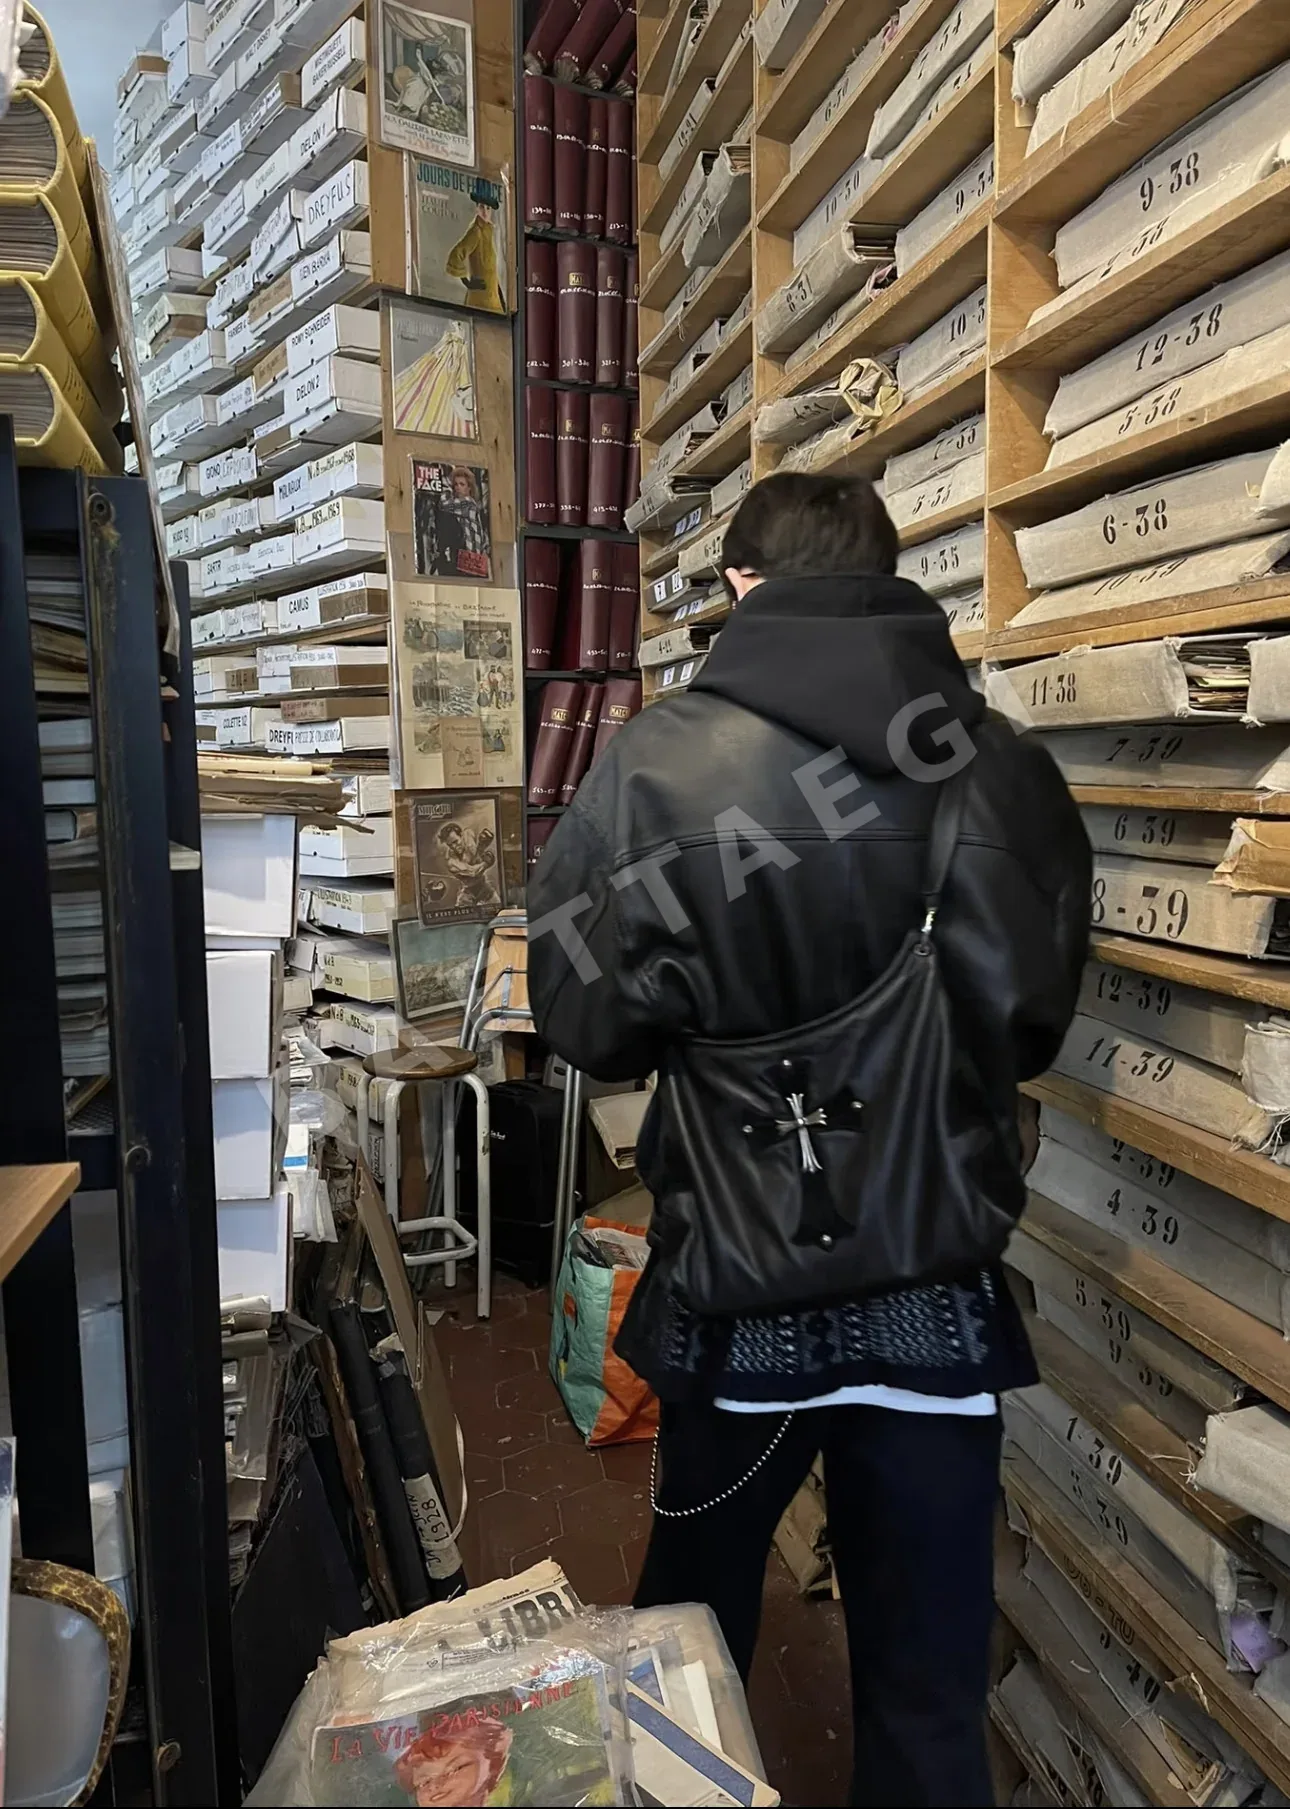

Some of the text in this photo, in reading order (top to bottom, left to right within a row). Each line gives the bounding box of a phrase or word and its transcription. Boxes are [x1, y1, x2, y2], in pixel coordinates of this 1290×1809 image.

[299, 130, 321, 157] DELON
[308, 172, 352, 226] DREYFUS
[416, 161, 451, 189] JOURS
[451, 171, 465, 192] DE
[824, 169, 860, 225] 10-30
[1139, 151, 1200, 212] 9-38
[304, 312, 332, 340] SCHNEIDER
[1135, 303, 1224, 372] 12-38
[295, 374, 321, 402] DELON 2
[1118, 386, 1182, 436] 5-38
[278, 476, 302, 501] MALRAUX
[416, 477, 443, 493] FACE
[418, 465, 440, 481] THE
[1102, 498, 1169, 545] 6-38
[920, 546, 960, 578] 9-35
[288, 596, 310, 615] CAMUS
[1030, 671, 1078, 706] 11-38
[223, 715, 242, 730] COLETTE
[453, 908, 471, 916] PLUS
[1091, 878, 1189, 939] 8-39
[1097, 971, 1172, 1017] 12-39
[1085, 1037, 1176, 1083] 11-39
[1106, 1188, 1179, 1245] 4-39
[1075, 1277, 1131, 1342] 5-39
[421, 1497, 450, 1543] 1928
[331, 1681, 576, 1765] LA VIE PARISIENNE
